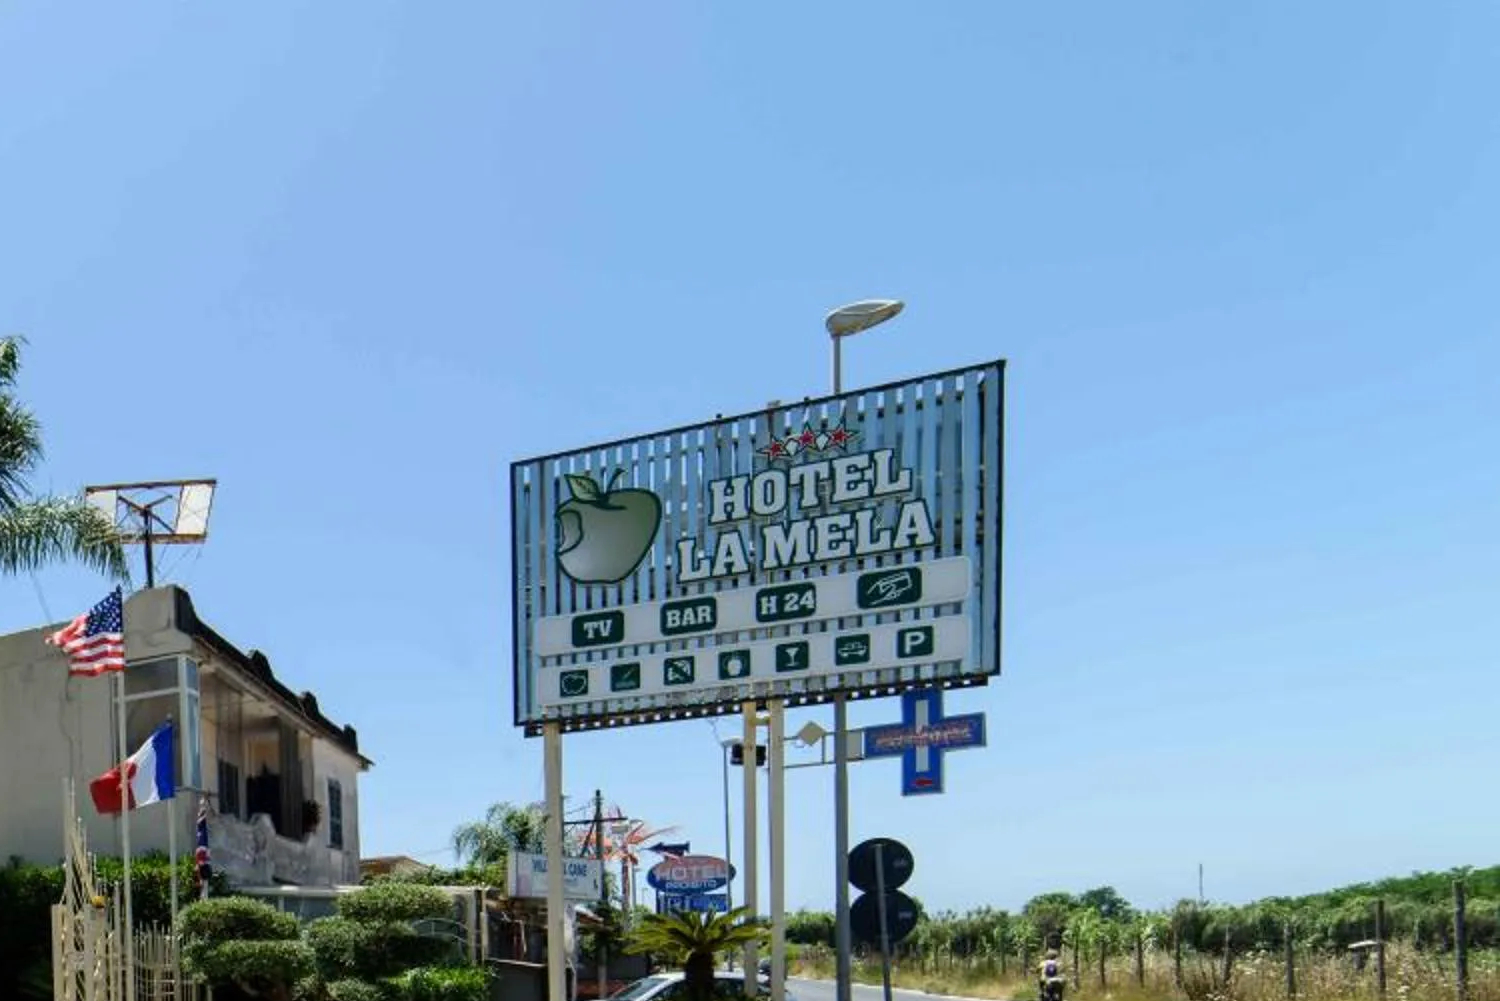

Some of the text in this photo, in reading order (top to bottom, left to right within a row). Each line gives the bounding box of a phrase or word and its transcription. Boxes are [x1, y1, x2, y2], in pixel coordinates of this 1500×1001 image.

[708, 448, 913, 525] HOTEL
[675, 498, 937, 582] LA MELA
[759, 590, 817, 616] H 24
[583, 619, 613, 639] TV
[665, 604, 714, 629] BAR
[903, 631, 925, 655] P
